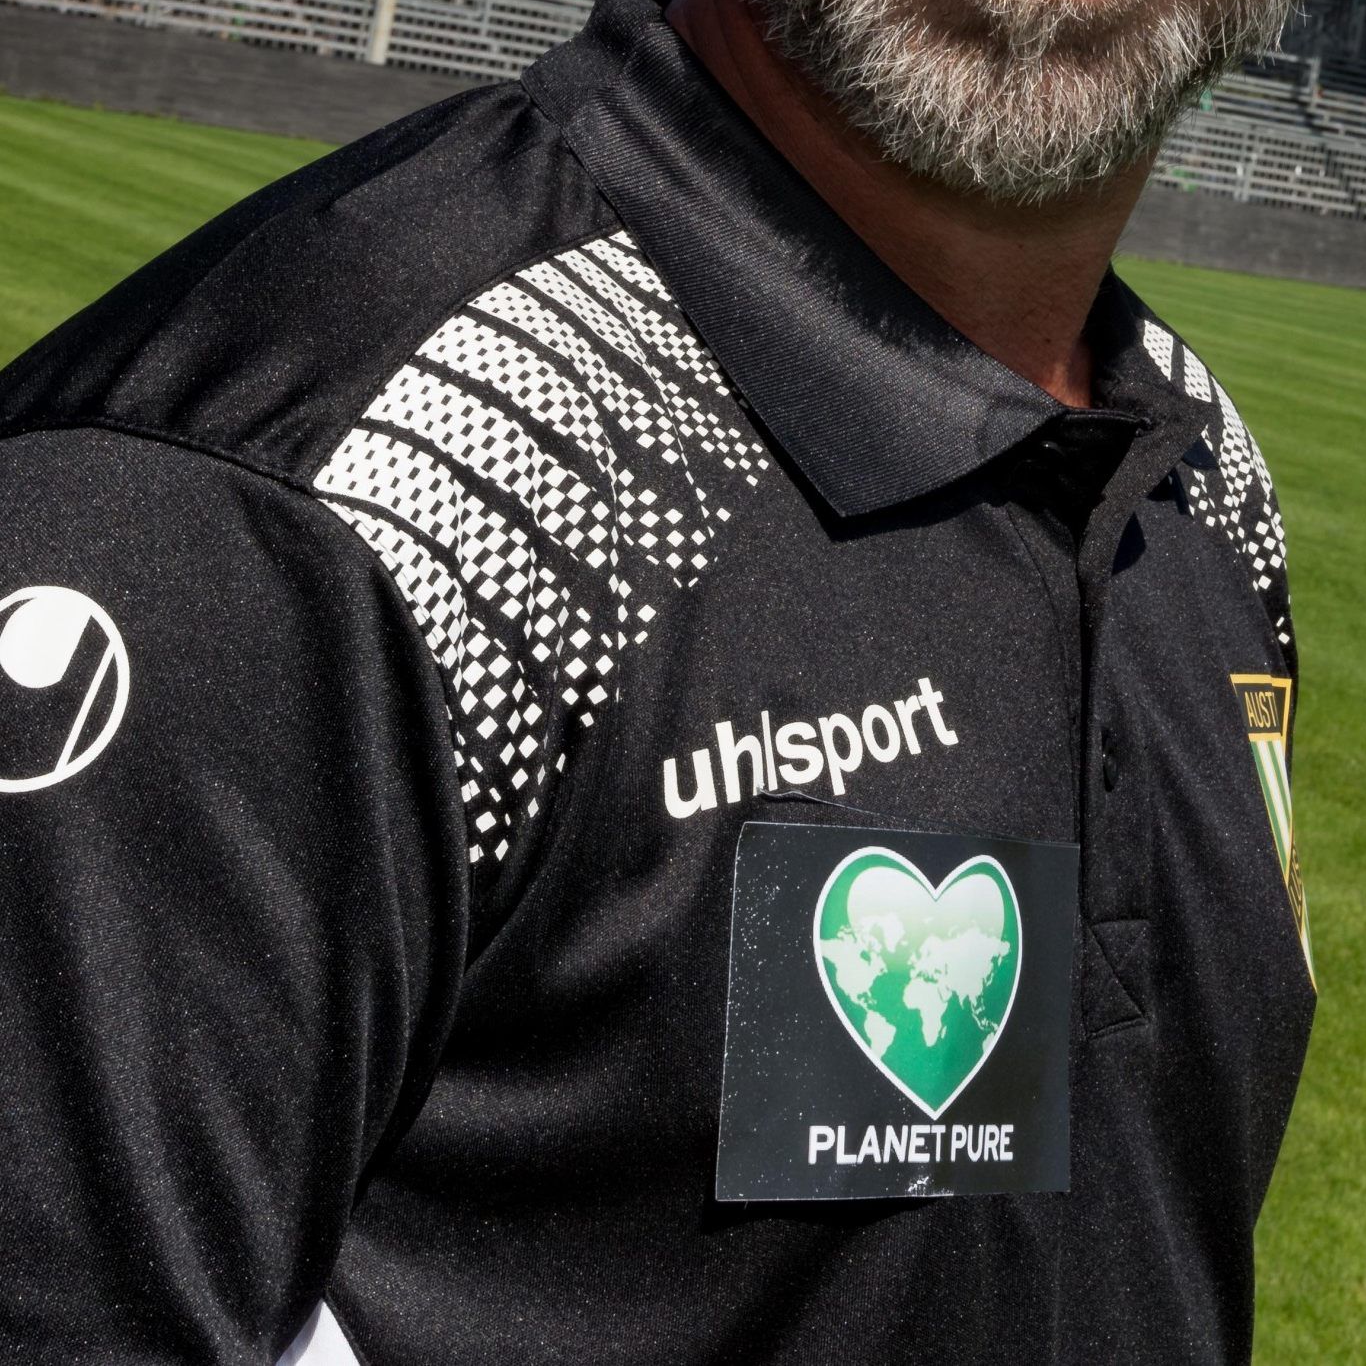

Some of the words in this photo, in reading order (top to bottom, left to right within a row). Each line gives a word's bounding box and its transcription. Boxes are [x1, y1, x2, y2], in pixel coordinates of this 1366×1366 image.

[663, 677, 959, 819] uhlsport
[807, 1124, 947, 1165] PLANET
[950, 1123, 1014, 1163] PURE
